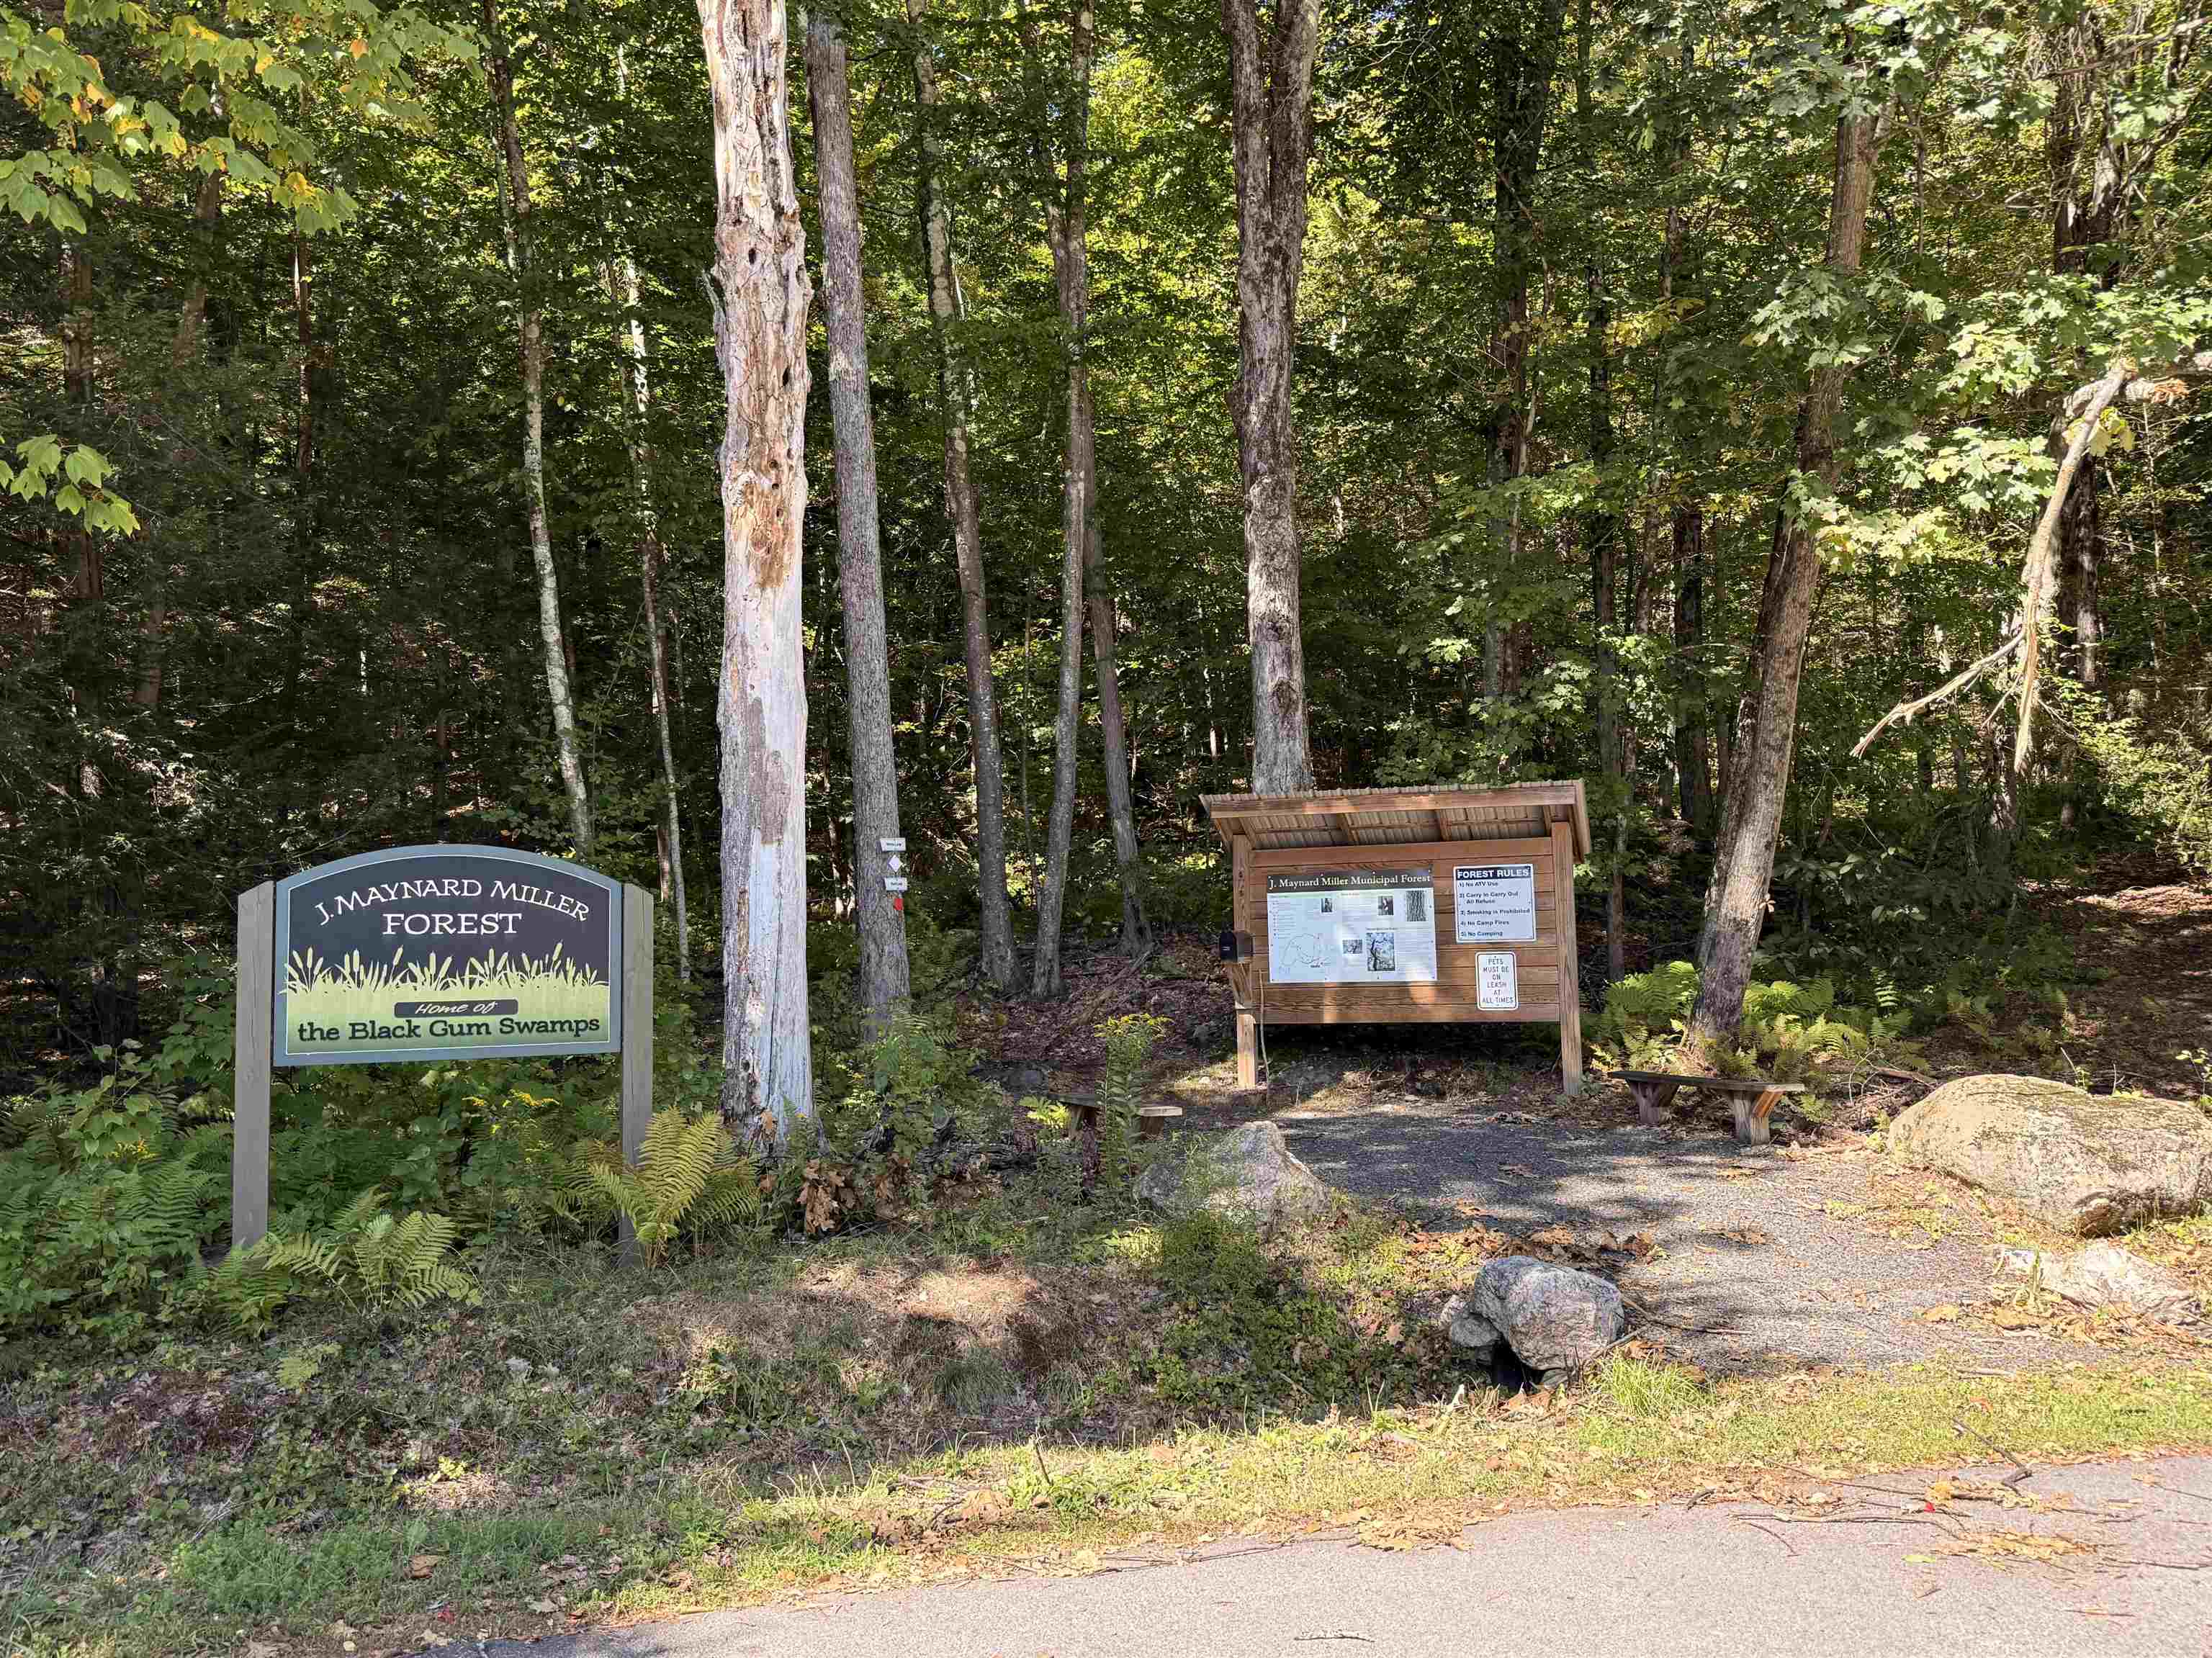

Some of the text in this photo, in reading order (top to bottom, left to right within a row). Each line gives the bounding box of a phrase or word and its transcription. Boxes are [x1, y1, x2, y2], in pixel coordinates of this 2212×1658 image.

[1269, 874, 1431, 890] J. Maynard Miller Municipal Forest
[1457, 870, 1494, 878] FOREST
[315, 879, 590, 926] J. MAYNARD MILLER
[382, 913, 523, 936] FOREST
[413, 1001, 498, 1015] Home of
[297, 1017, 600, 1042] the Black Gum Swamps
